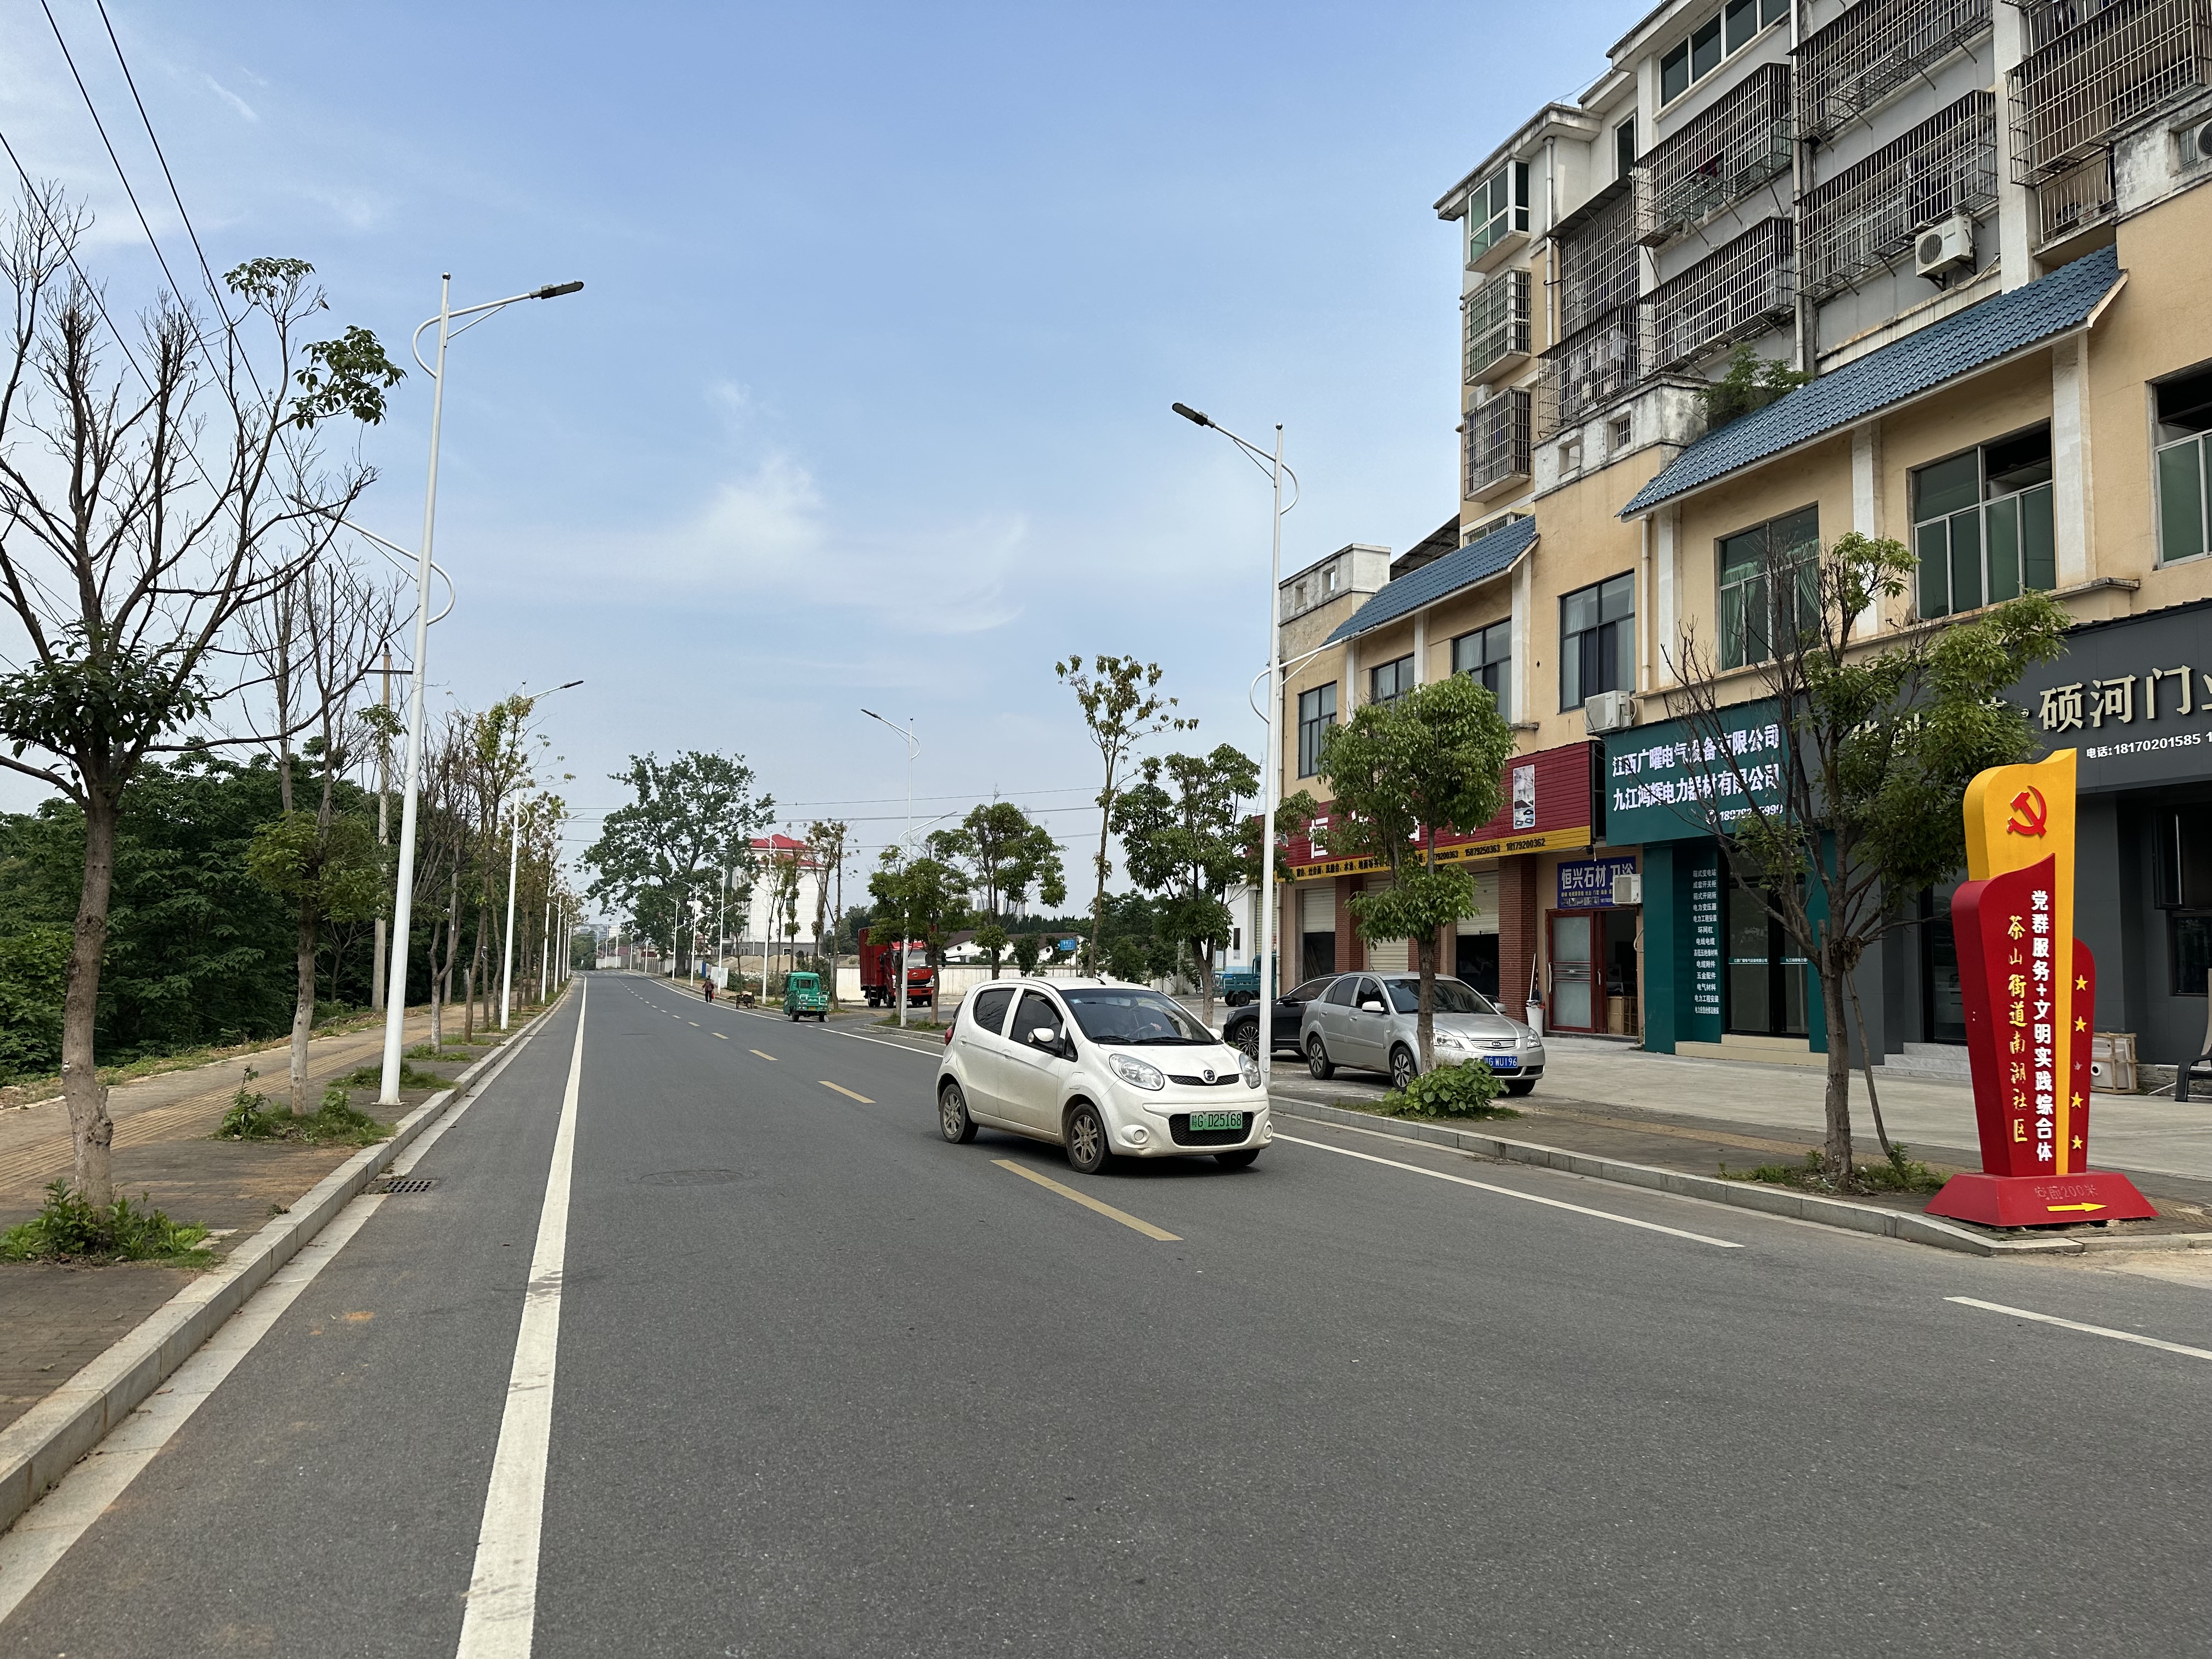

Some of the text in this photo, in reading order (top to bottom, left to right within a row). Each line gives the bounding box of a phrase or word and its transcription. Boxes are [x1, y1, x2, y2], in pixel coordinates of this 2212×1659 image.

[2038, 664, 2212, 733] 硕河门
[1612, 724, 1779, 777] 江西广曜电气设备有限公司
[1613, 763, 1779, 811] 九江鸿辉电力器材有限公司
[1561, 865, 1606, 889] 恒兴石材
[1693, 902, 1717, 911] 电力变压器
[1694, 994, 1719, 1002] 电力工程安装
[2007, 915, 2028, 1143] 茶山街道南湖社区
[2030, 890, 2053, 1162] 党群服务+文明实践综合体
